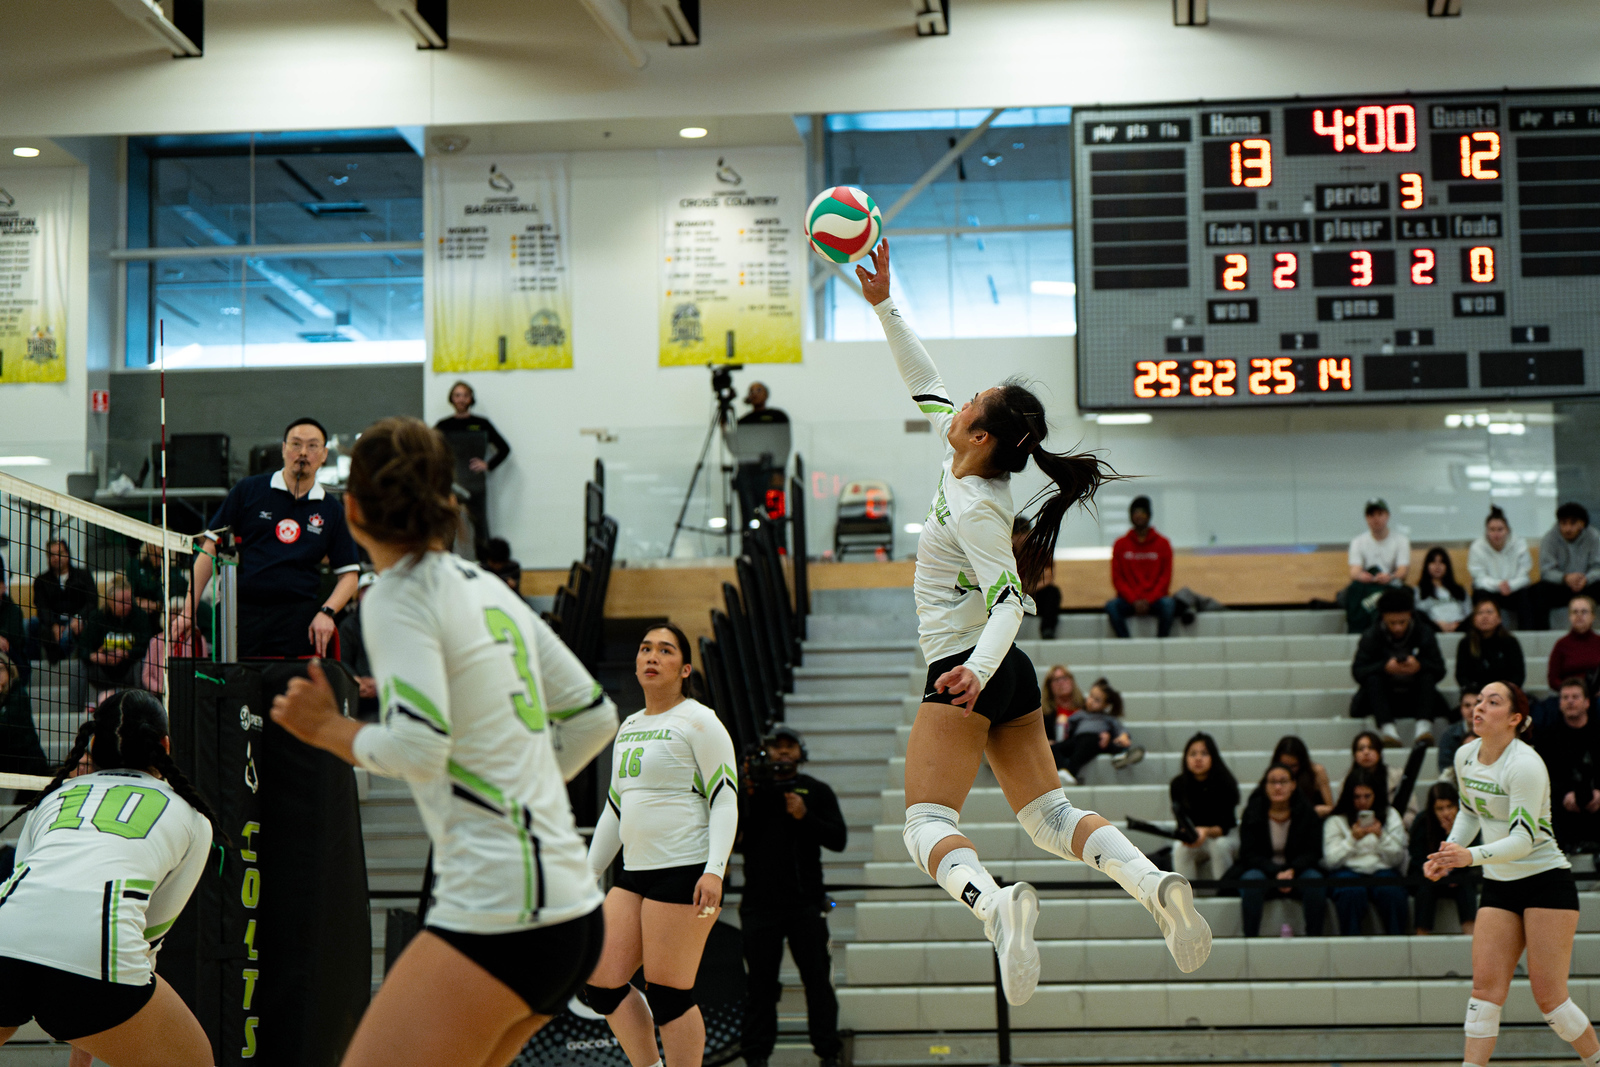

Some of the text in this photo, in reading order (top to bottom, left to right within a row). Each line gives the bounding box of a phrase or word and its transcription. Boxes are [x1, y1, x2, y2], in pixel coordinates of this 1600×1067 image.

[1210, 113, 1261, 135] Home
[1313, 104, 1416, 153] 4:00
[1432, 105, 1496, 127] Guests
[1230, 138, 1272, 187] 13
[1460, 131, 1500, 180] 12
[1323, 184, 1381, 209] period
[1400, 172, 1423, 209] 3
[1323, 218, 1383, 243] player
[1223, 253, 1247, 290] 2
[1272, 252, 1297, 289] 2
[1350, 250, 1373, 287] 3
[1411, 248, 1435, 285] 2
[1470, 246, 1494, 283] 0
[1333, 300, 1379, 320] game
[1134, 359, 1236, 398] 25 22
[1249, 357, 1351, 395] 25 14
[484, 607, 545, 732] 3
[618, 747, 644, 778] 16
[45, 784, 170, 839] 10
[240, 821, 260, 1058] COLTS
